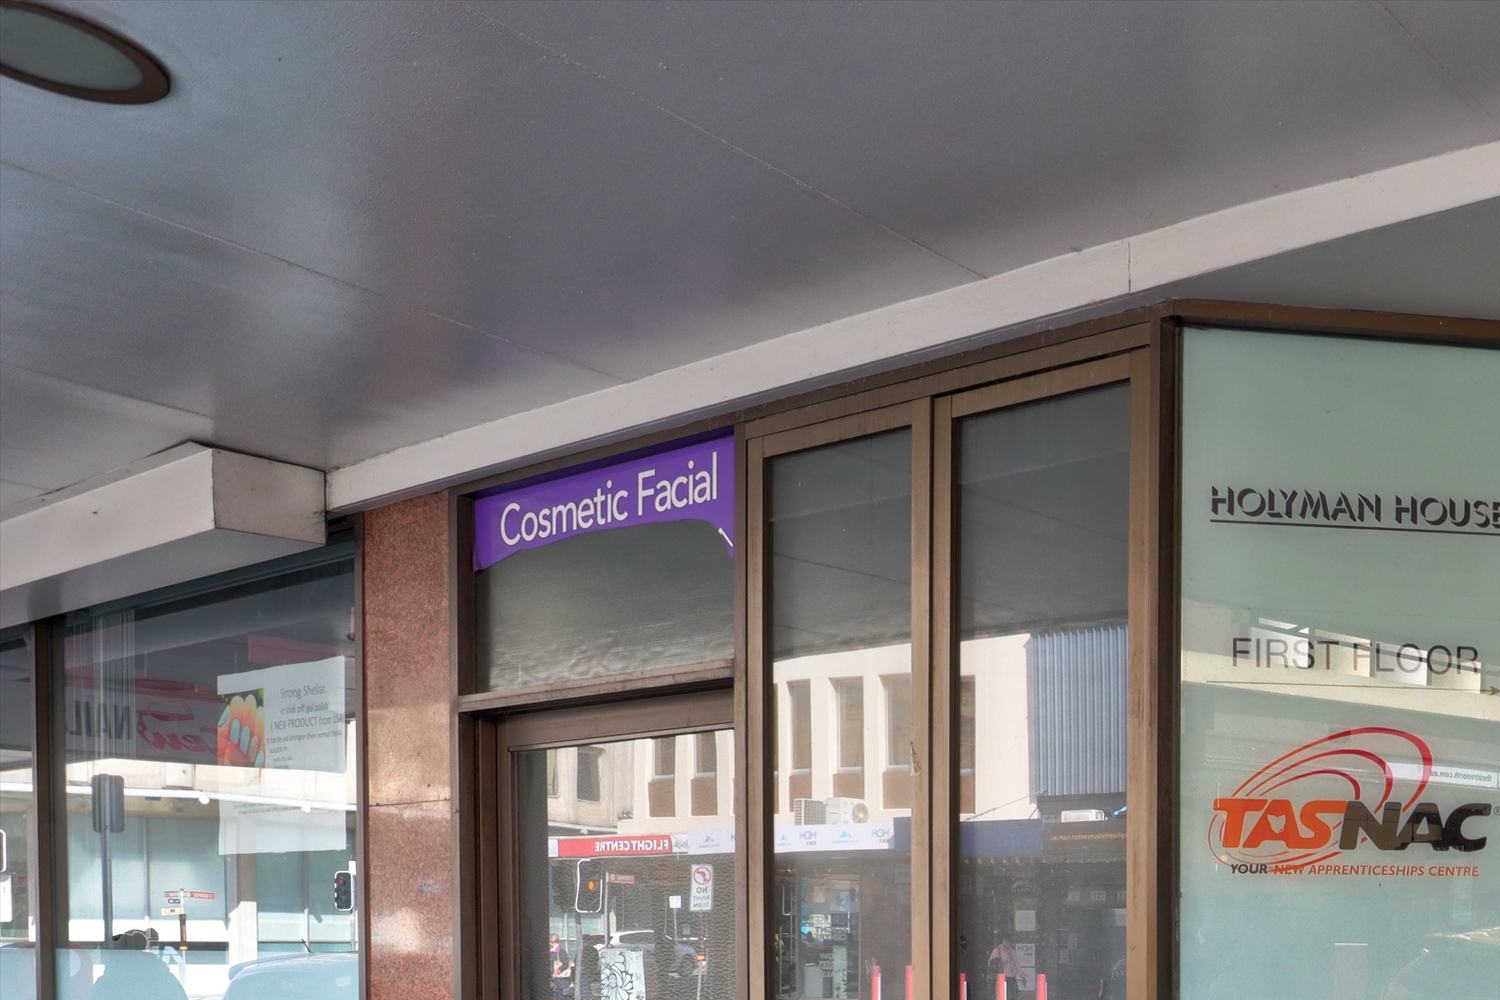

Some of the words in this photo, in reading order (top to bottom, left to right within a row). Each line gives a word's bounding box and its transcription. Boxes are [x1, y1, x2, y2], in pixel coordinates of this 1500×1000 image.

[500, 480, 629, 546] Cosmetic
[637, 451, 718, 516] Facial
[1210, 485, 1382, 523] HOLYMAN
[1232, 637, 1340, 670] FIRST
[1352, 641, 1480, 675] FLOOR
[281, 687, 302, 699] Strong
[303, 683, 326, 696] Shellac
[274, 719, 288, 731] NEW
[288, 716, 318, 730] PRODUCT
[1213, 797, 1493, 853] TASNAC
[1230, 863, 1268, 876] YOUR
[1308, 864, 1425, 877] APPRENTICESHIPS
[1428, 866, 1480, 877] CENTRE
